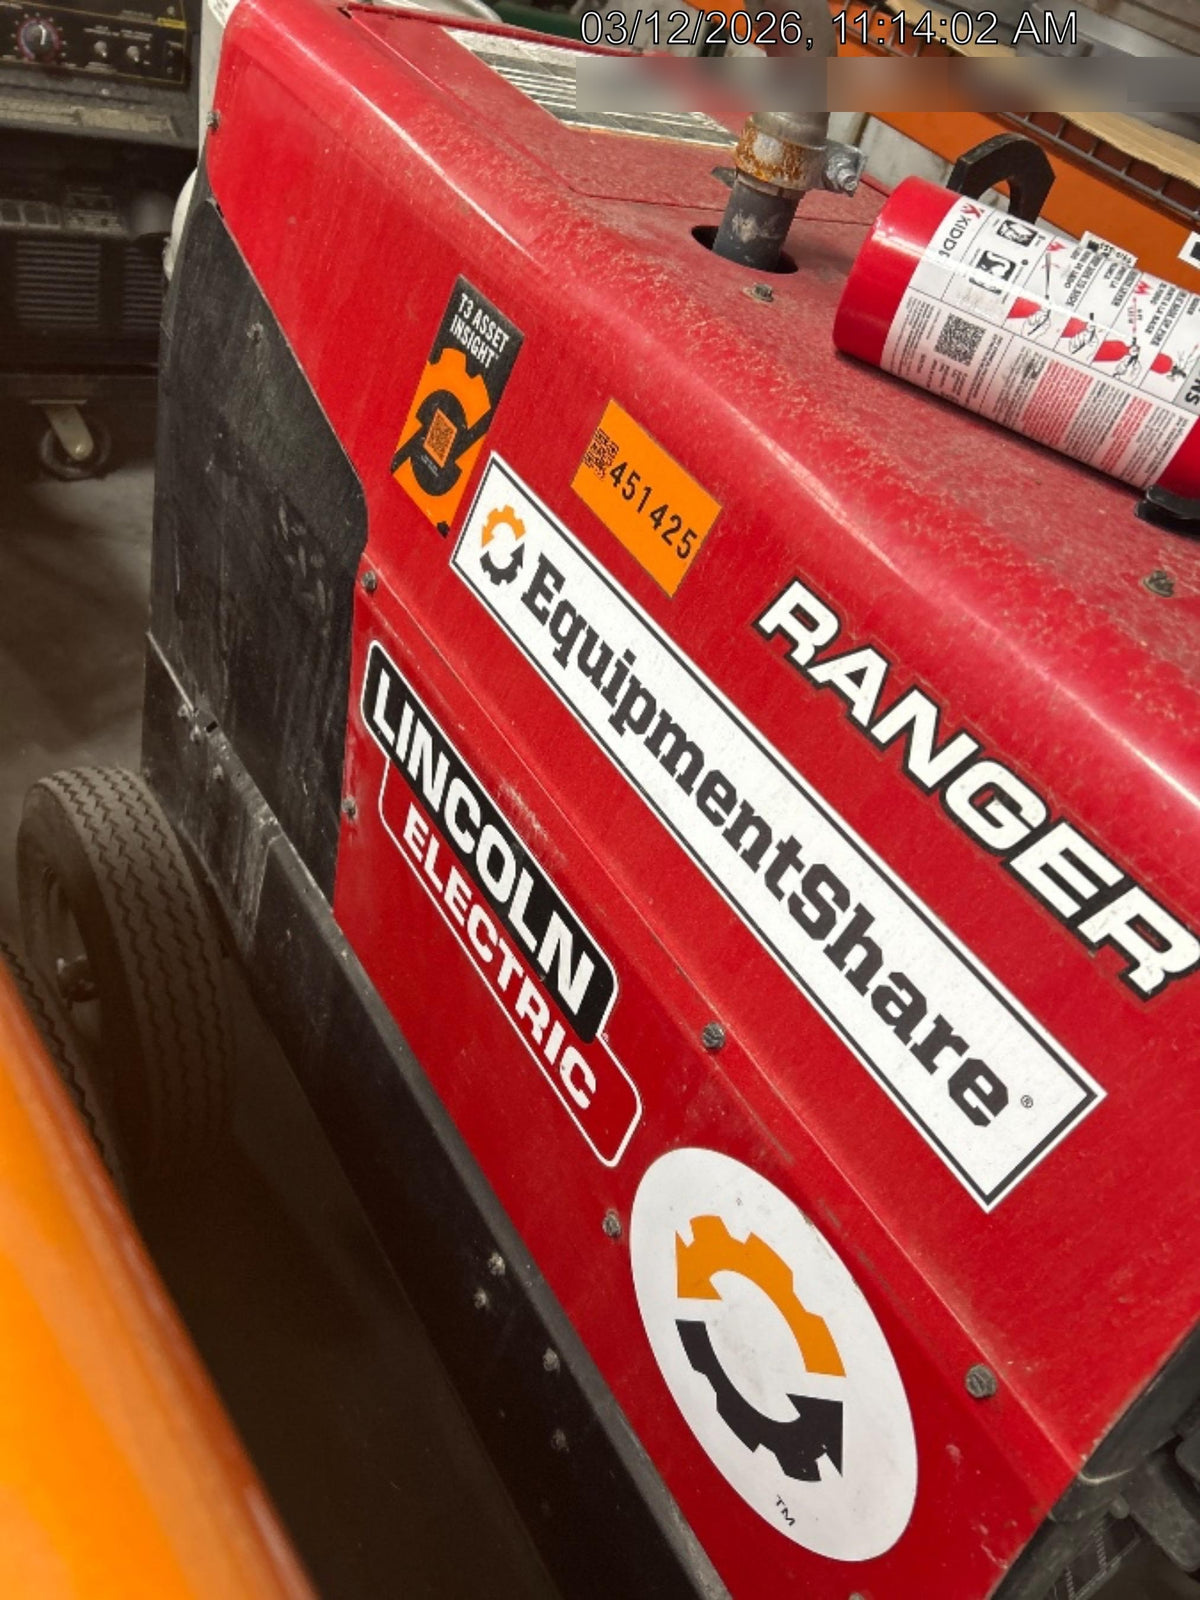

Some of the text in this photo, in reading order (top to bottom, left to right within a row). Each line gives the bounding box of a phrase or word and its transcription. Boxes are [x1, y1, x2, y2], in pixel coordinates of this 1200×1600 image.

[449, 313, 497, 369] INSIGHT
[458, 292, 510, 352] T3 ASSET
[609, 461, 698, 559] 451425
[373, 668, 595, 1016] LINCOLN
[521, 552, 1009, 1128] EquipmentShare
[754, 578, 1200, 997] RANGER
[403, 802, 597, 1110] ELECTRIC
